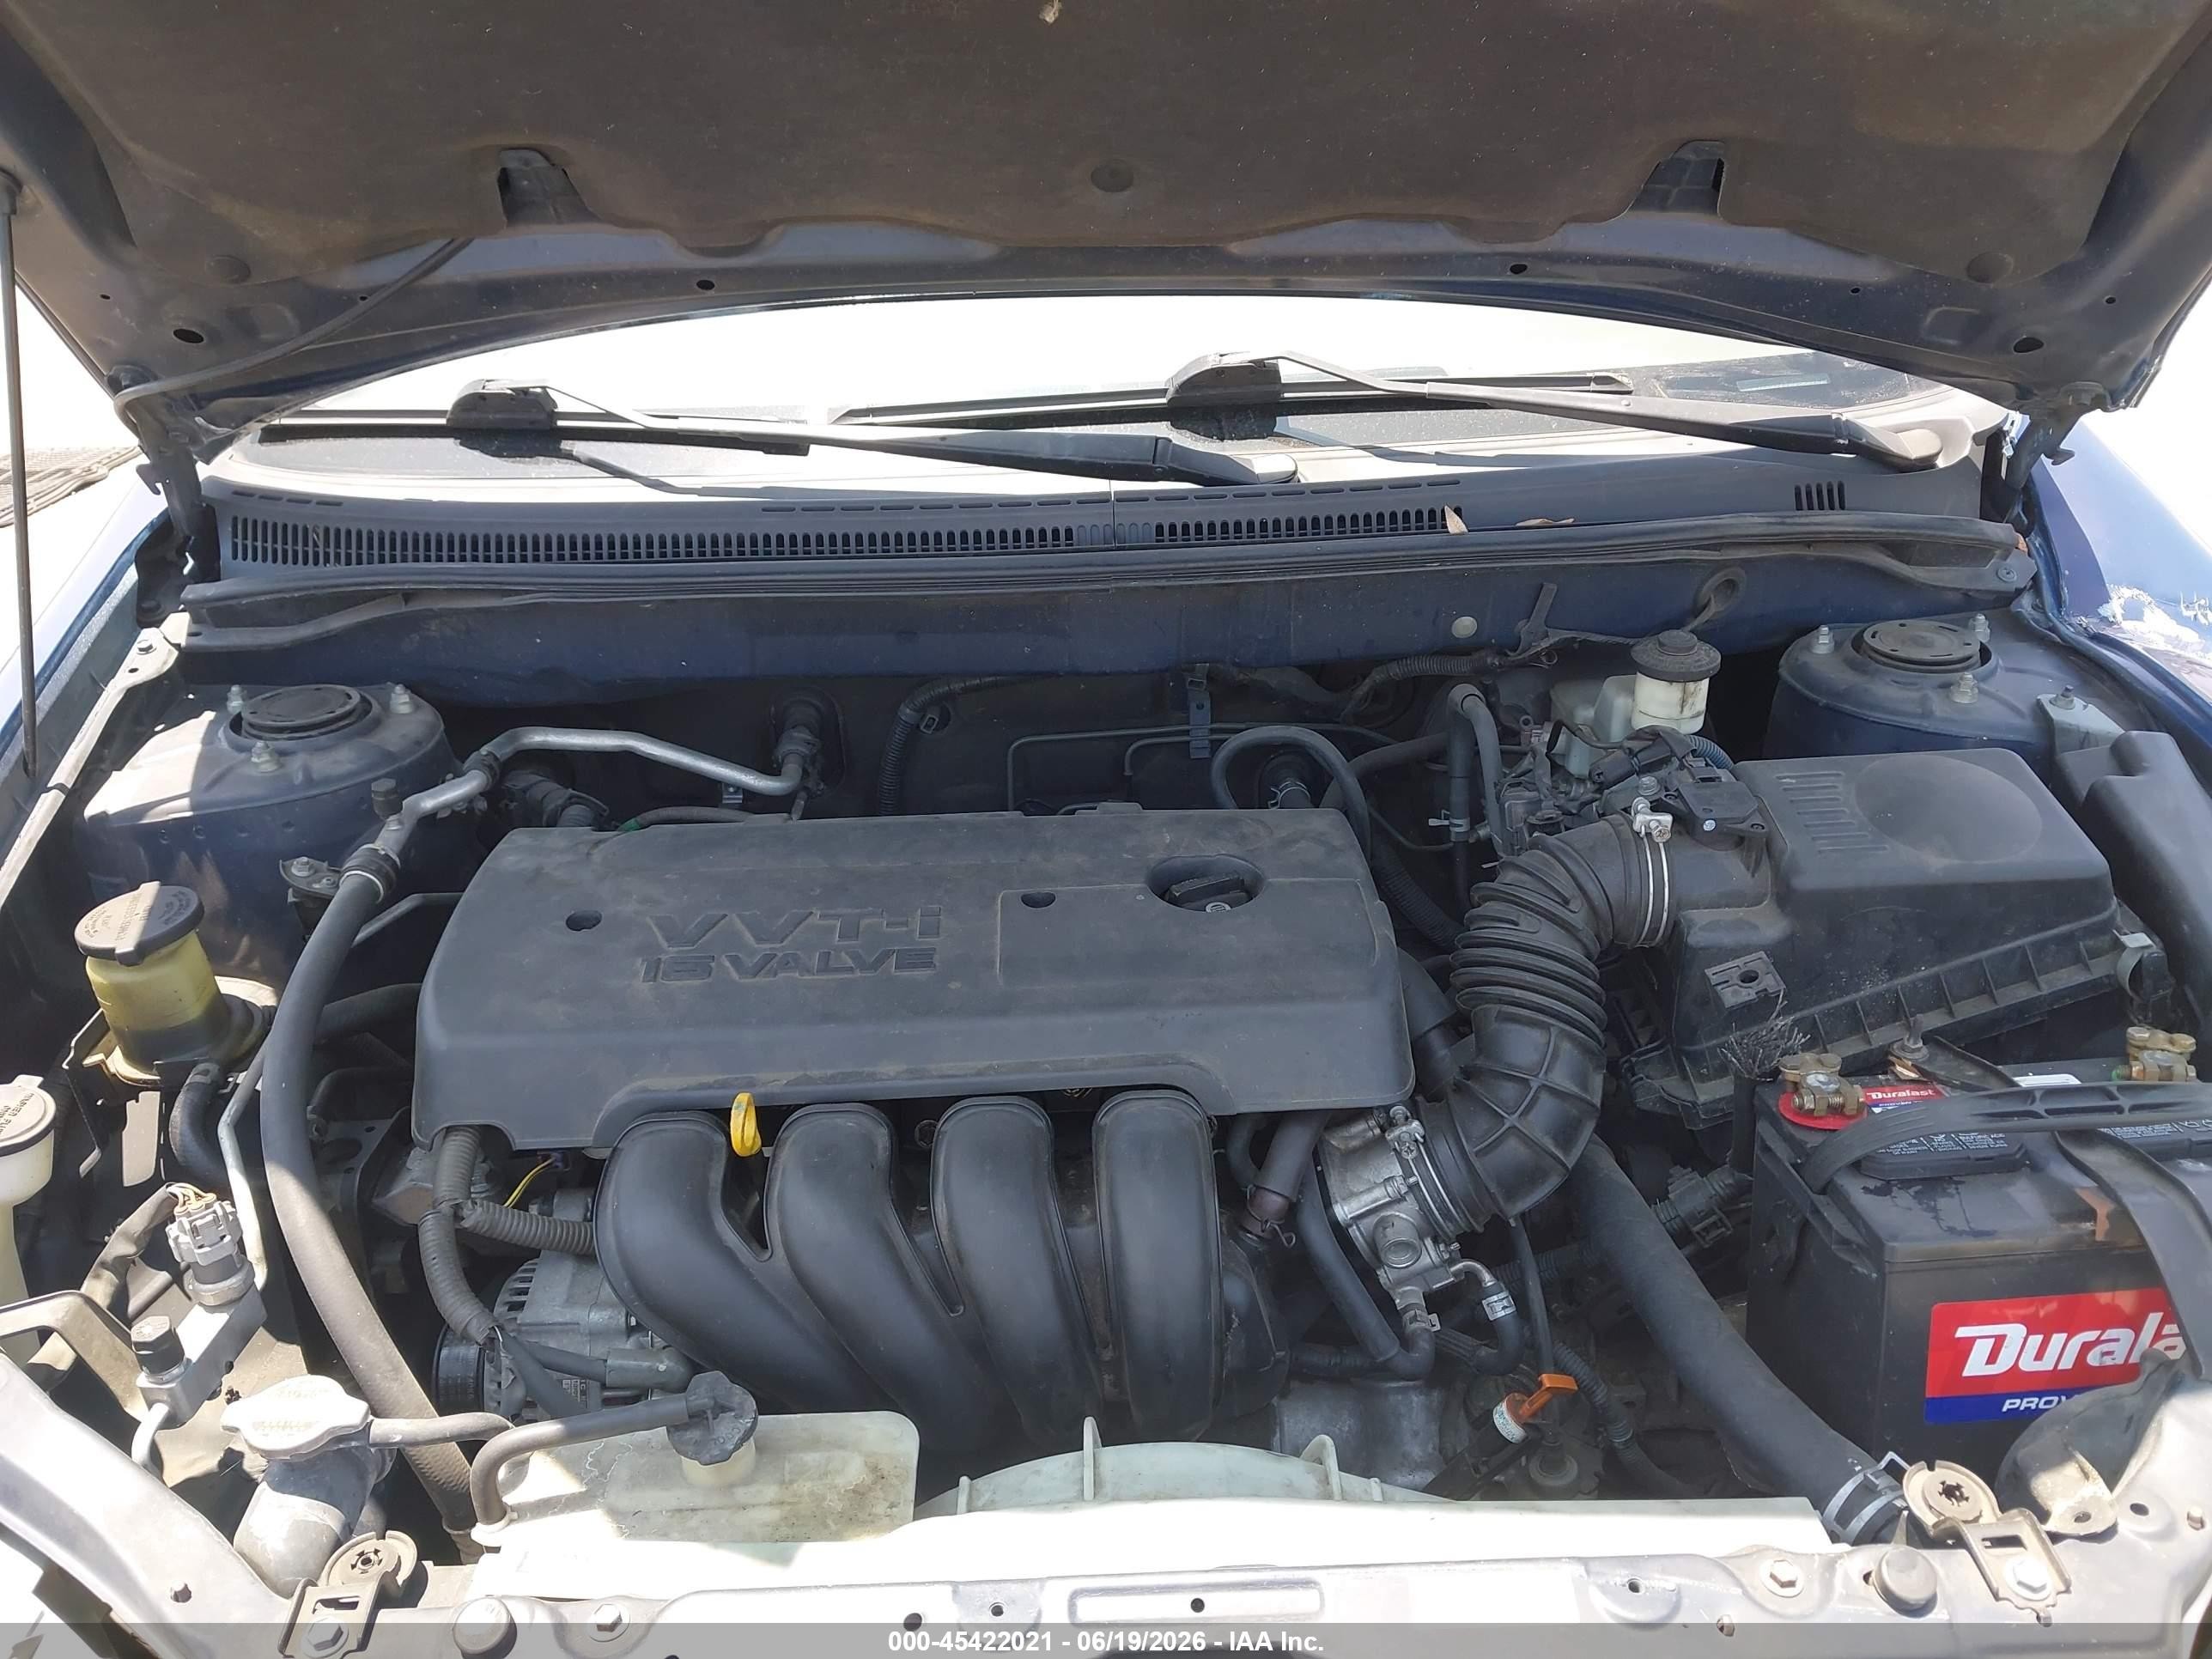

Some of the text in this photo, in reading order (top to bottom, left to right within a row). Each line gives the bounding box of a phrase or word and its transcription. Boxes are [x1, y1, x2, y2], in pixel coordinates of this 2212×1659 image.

[641, 946, 937, 983] 16 VALVE
[1866, 1088, 1936, 1099] Duralast
